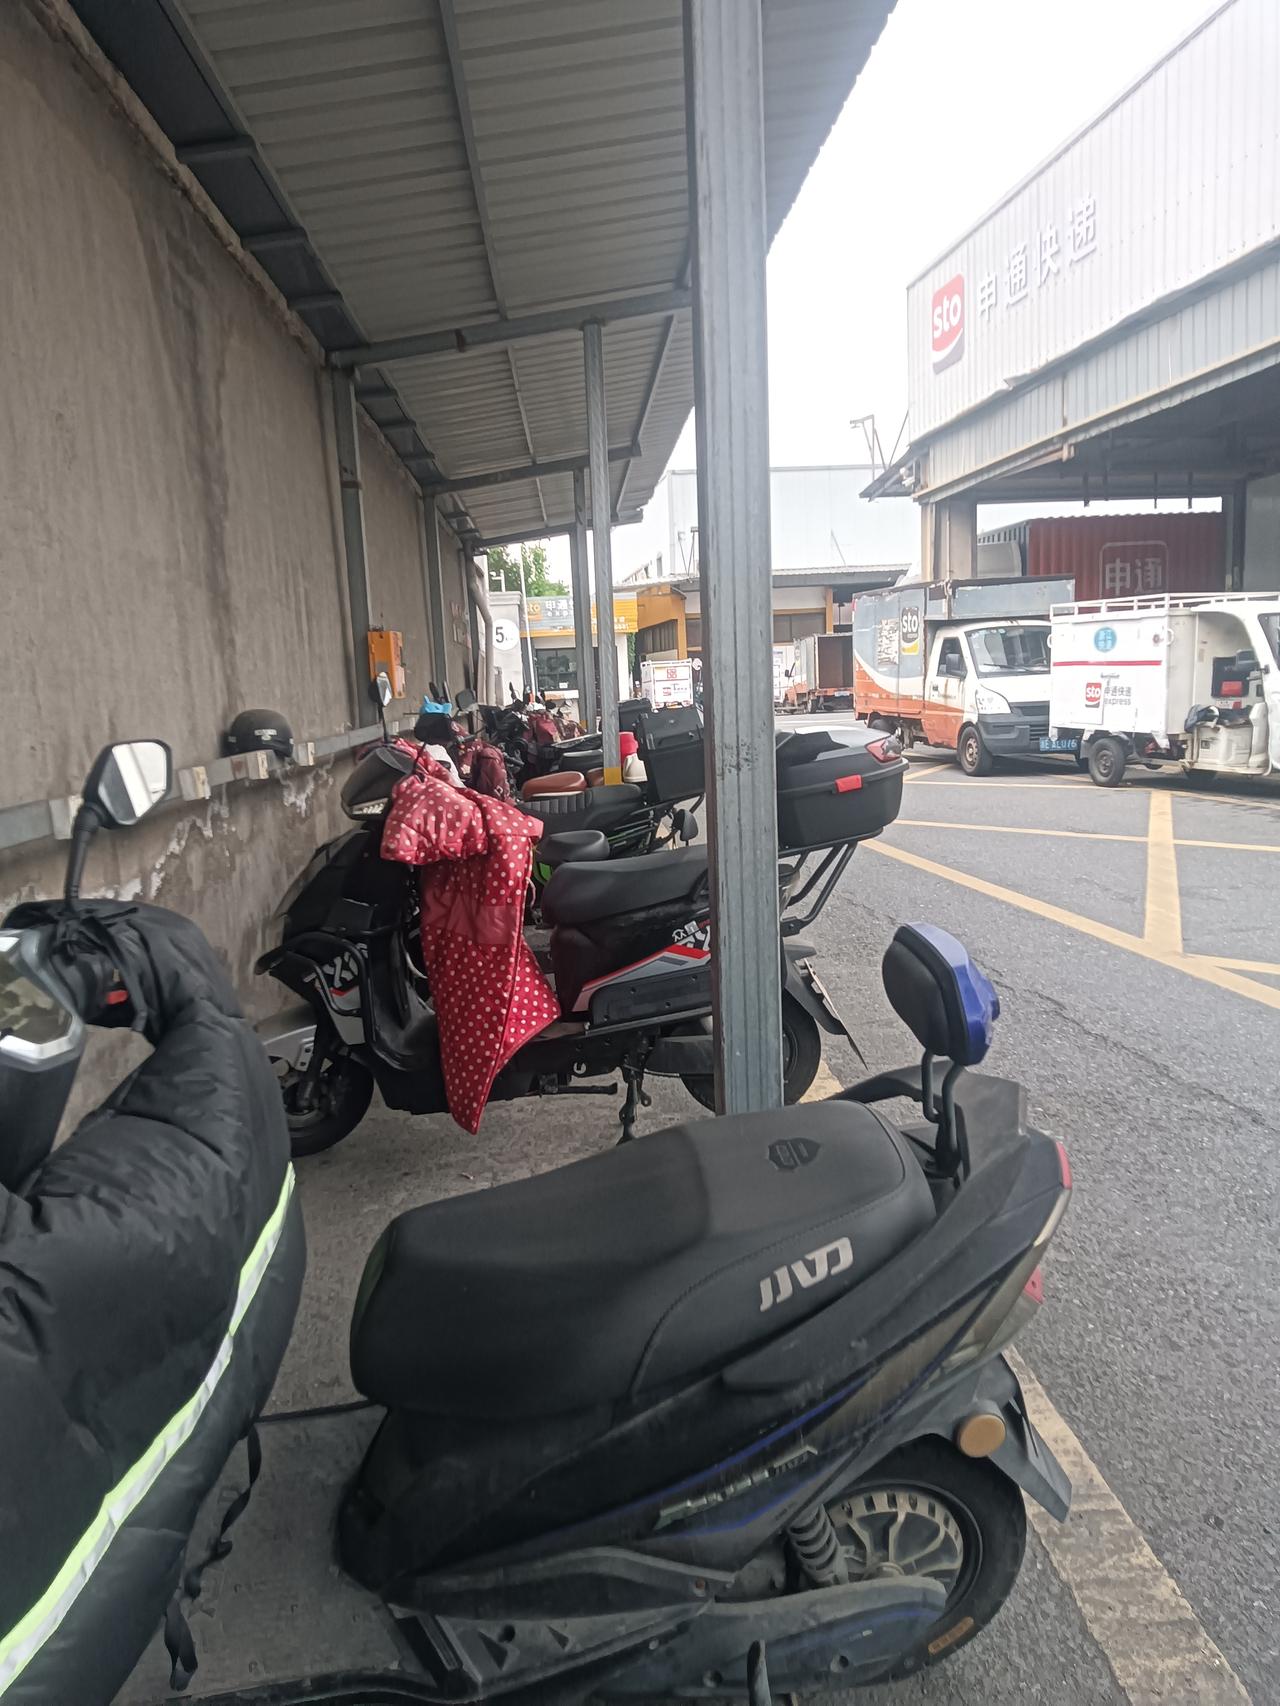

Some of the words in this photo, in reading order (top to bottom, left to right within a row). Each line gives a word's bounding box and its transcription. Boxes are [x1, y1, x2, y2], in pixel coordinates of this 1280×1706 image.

[977, 193, 1097, 321] 申通快递
[932, 291, 962, 339] sto
[1105, 557, 1162, 595] 申通
[495, 626, 505, 643] 5
[902, 611, 918, 633] sto
[1086, 685, 1100, 698] sto
